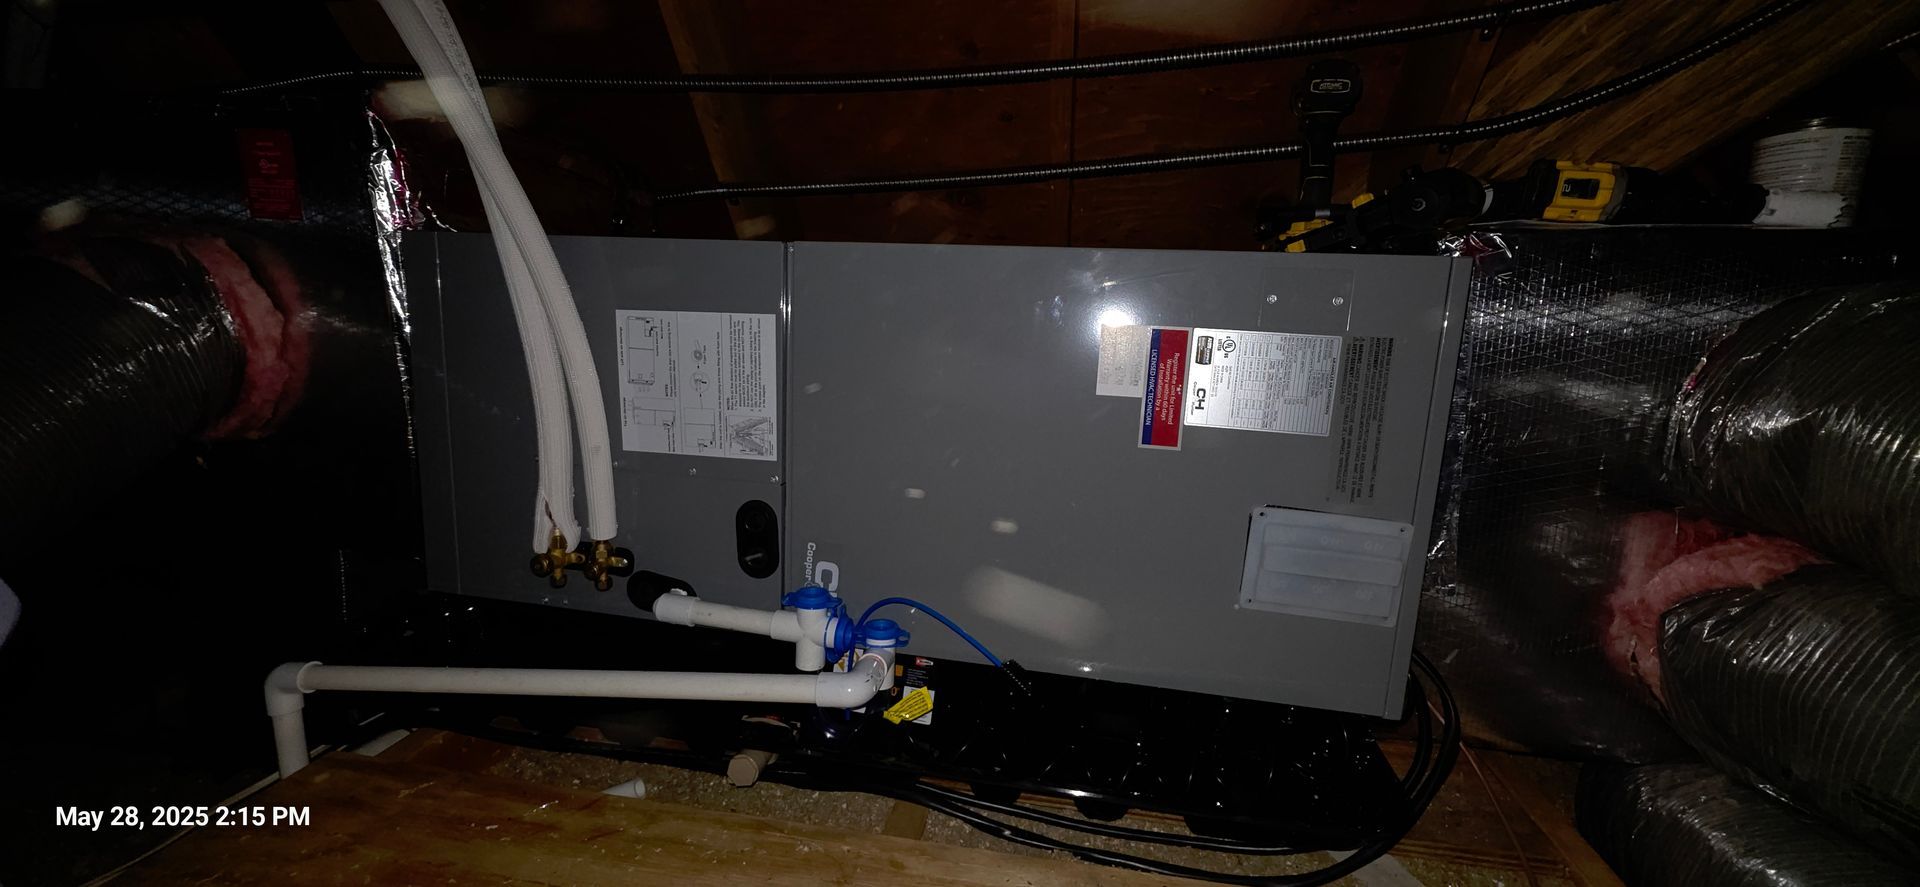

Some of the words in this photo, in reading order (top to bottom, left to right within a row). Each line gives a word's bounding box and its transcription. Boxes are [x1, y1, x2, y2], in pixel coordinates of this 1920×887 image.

[1150, 349, 1158, 377] LICENSED
[1165, 358, 1173, 383] Warranty
[1146, 393, 1154, 426] TECHNICIAN
[1195, 388, 1206, 410] CH
[804, 542, 816, 580] Cooper
